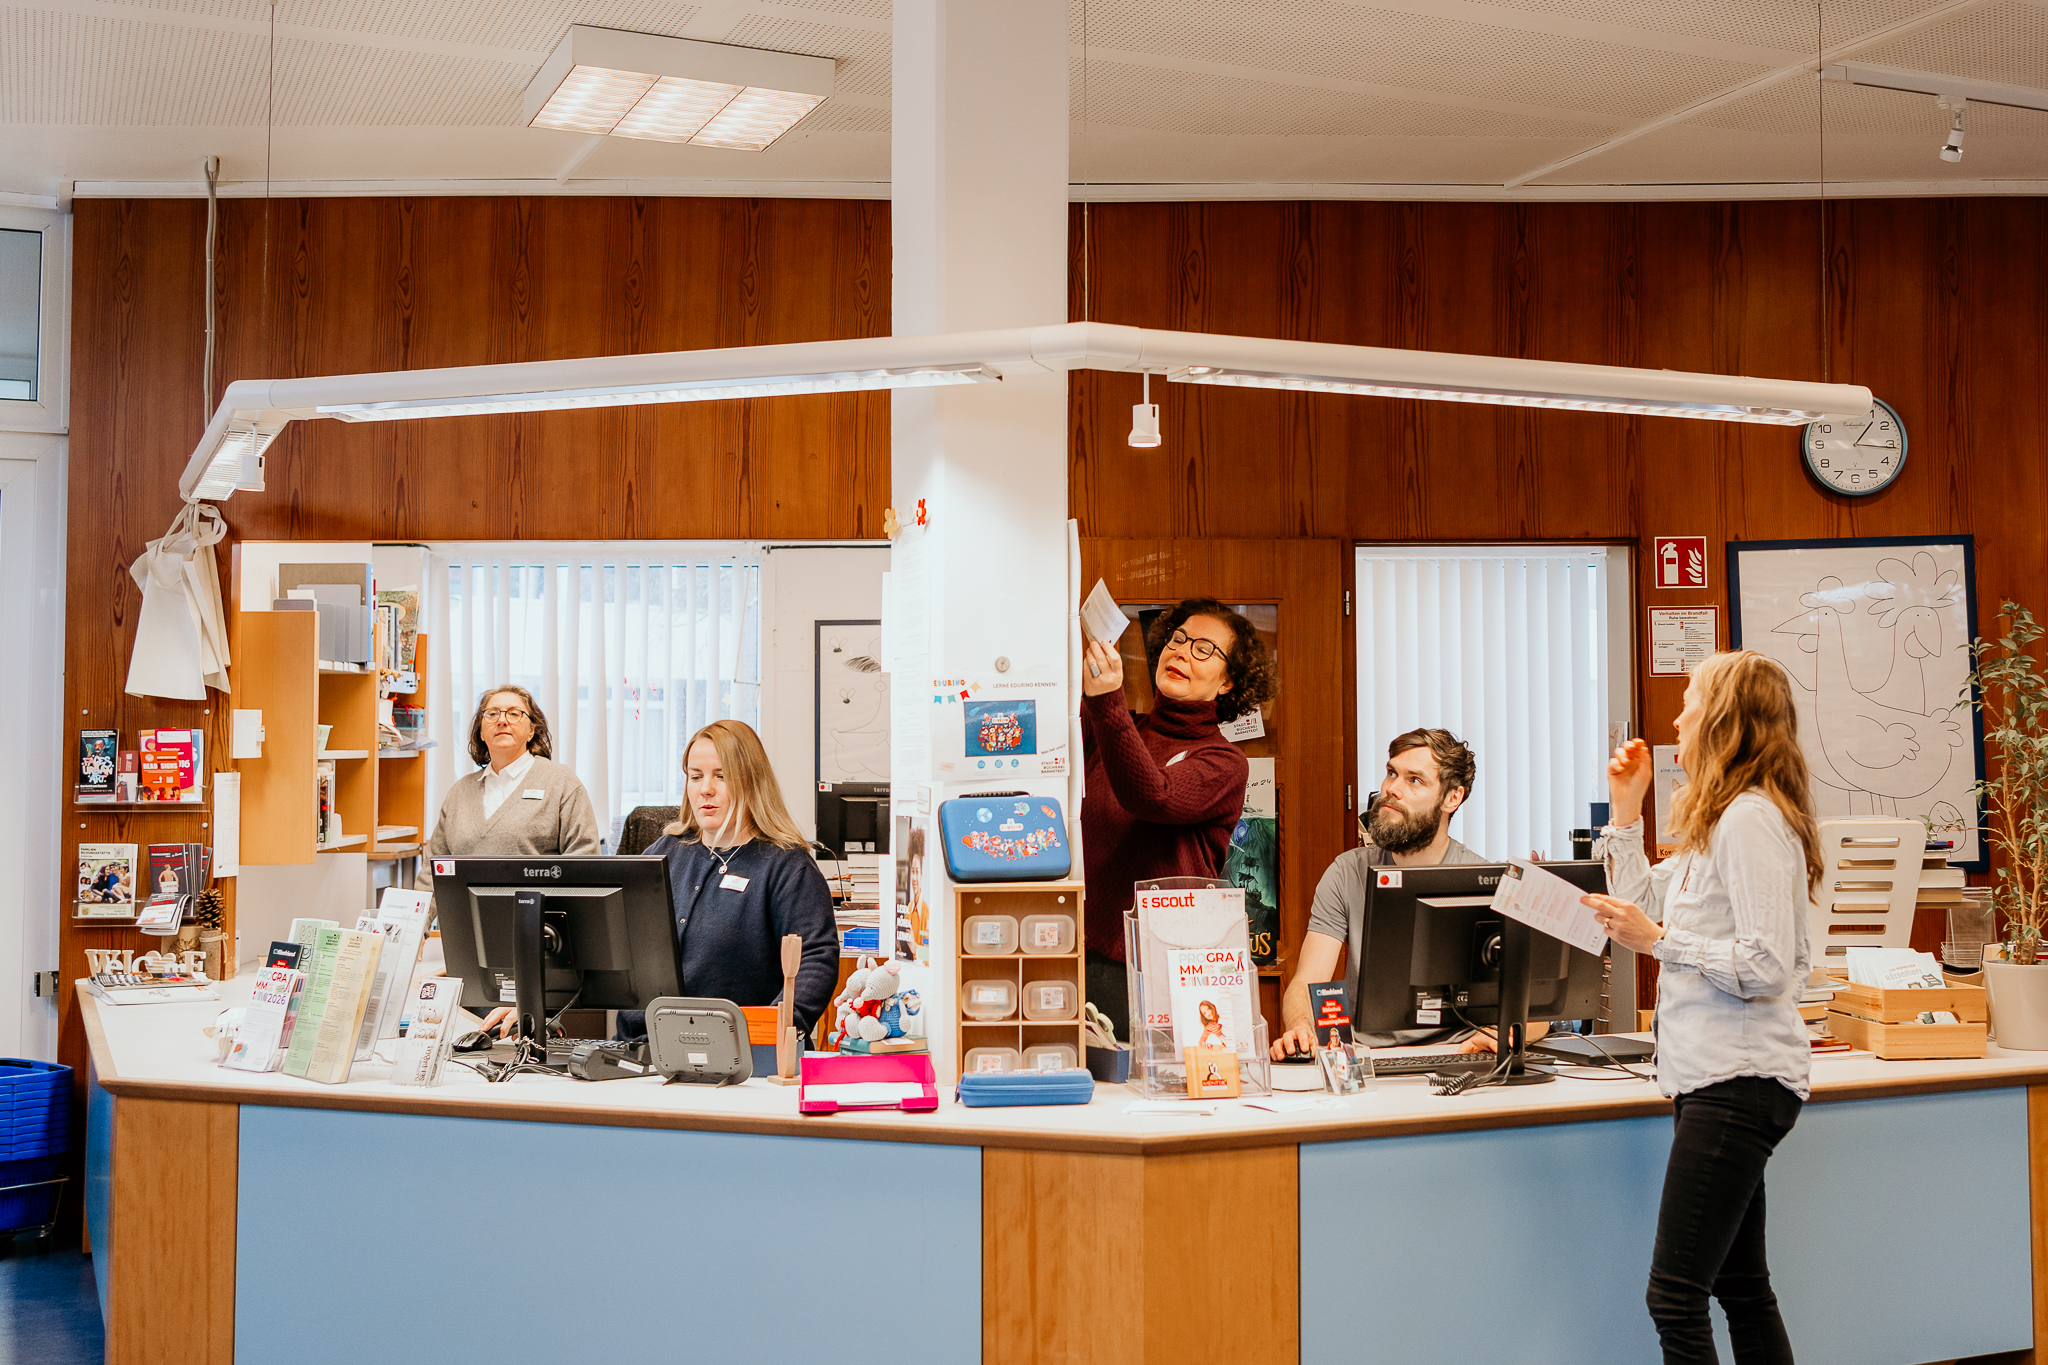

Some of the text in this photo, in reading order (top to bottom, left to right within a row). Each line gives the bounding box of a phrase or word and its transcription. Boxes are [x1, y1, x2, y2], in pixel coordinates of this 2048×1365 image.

[1870, 410, 1874, 418] 1
[1818, 424, 1832, 434] 10
[1880, 421, 1890, 430] 2
[1815, 440, 1824, 449] 9
[1886, 440, 1895, 449] 3
[1821, 459, 1830, 468] 8
[1881, 456, 1889, 465] 4
[1834, 471, 1843, 480] 7
[1851, 474, 1860, 483] 6
[1869, 470, 1878, 479] 5
[524, 867, 550, 877] terra
[1478, 875, 1500, 885] terr
[1151, 892, 1195, 908] scout
[1250, 932, 1271, 956] US
[1179, 952, 1235, 963] PROGRA
[1180, 965, 1203, 975] MM
[1885, 968, 1923, 980] Rätselheft
[1211, 975, 1244, 986] 2026
[255, 981, 268, 990] MM
[267, 994, 286, 1005] 2026
[1157, 1014, 1170, 1023] 25
